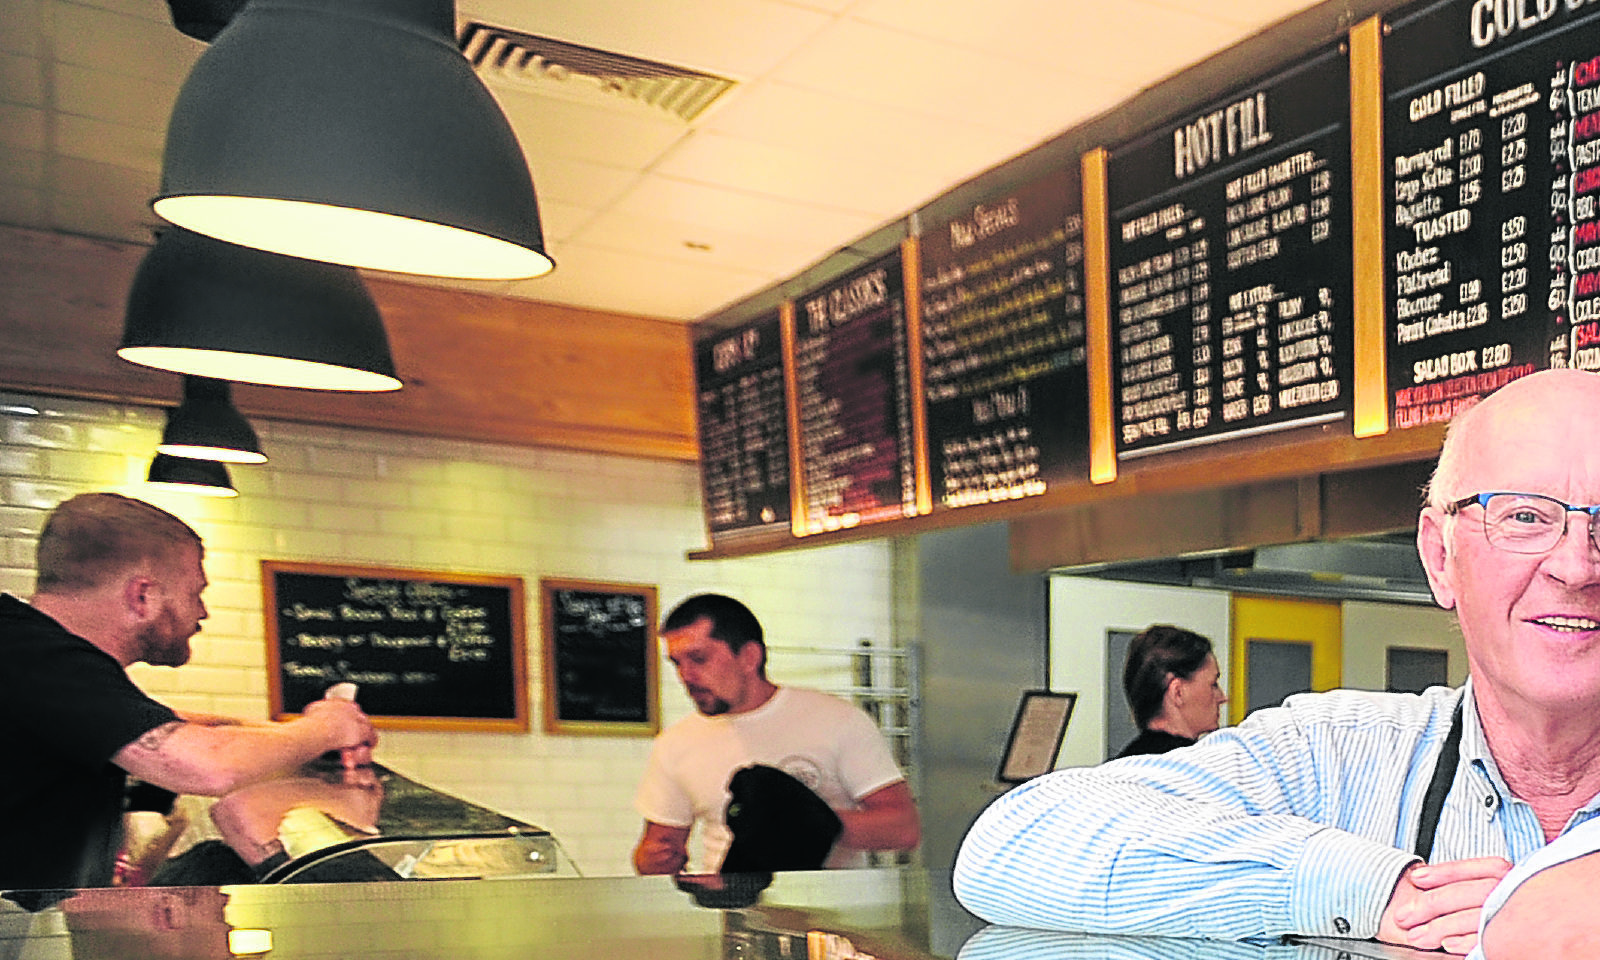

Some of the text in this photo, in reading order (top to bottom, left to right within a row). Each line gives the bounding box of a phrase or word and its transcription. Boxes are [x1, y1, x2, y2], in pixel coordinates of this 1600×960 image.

[1410, 89, 1442, 122] COLD
[1445, 72, 1486, 109] FILLED
[1174, 110, 1223, 178] HOT
[1413, 208, 1472, 243] TOASTED
[1413, 350, 1478, 384] SALAD BOX
